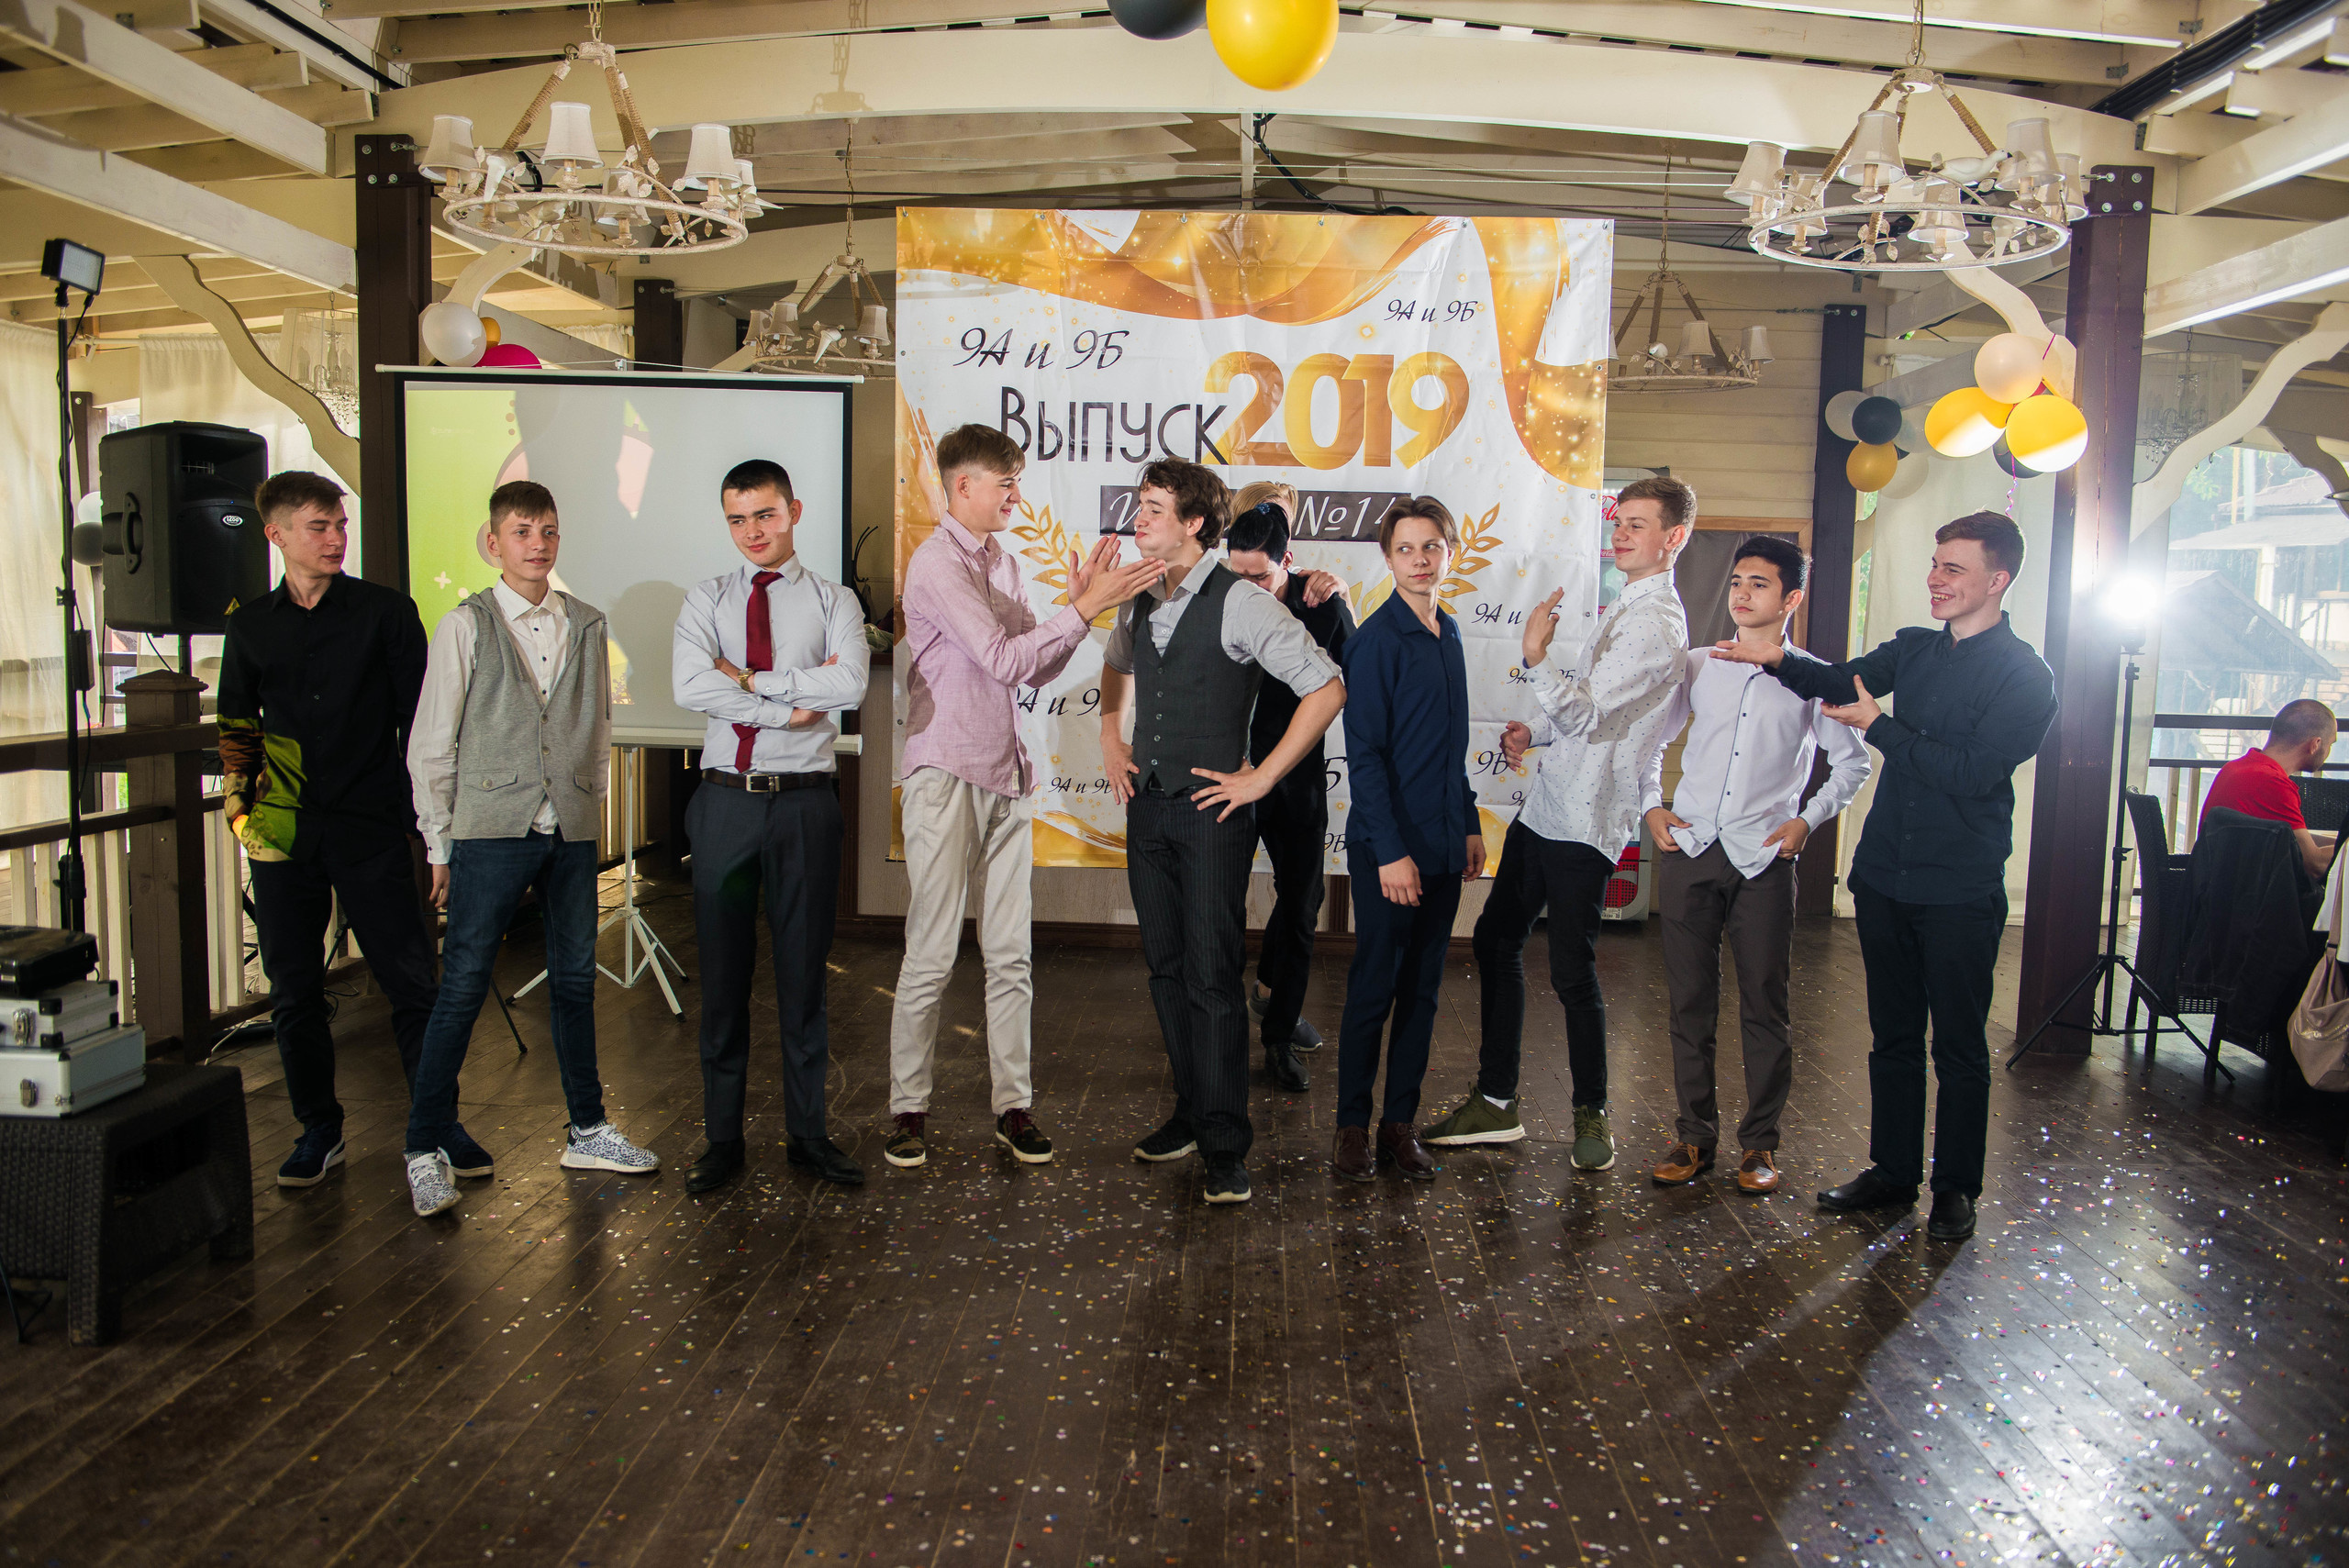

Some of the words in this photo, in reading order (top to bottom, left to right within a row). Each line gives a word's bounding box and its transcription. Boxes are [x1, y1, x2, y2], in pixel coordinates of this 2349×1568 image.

[1384, 299, 1416, 321] 9А
[1421, 307, 1437, 322] и
[1443, 300, 1478, 322] 9Б
[952, 328, 1014, 367] 9А
[1024, 342, 1054, 369] и
[1065, 329, 1130, 369] 9Б
[1203, 350, 1469, 470] 2019
[1471, 603, 1503, 624] 9А
[1508, 611, 1523, 624] и
[1048, 697, 1068, 716] и
[1077, 688, 1102, 717] 9
[1048, 777, 1072, 793] 9А
[1075, 783, 1087, 794] и
